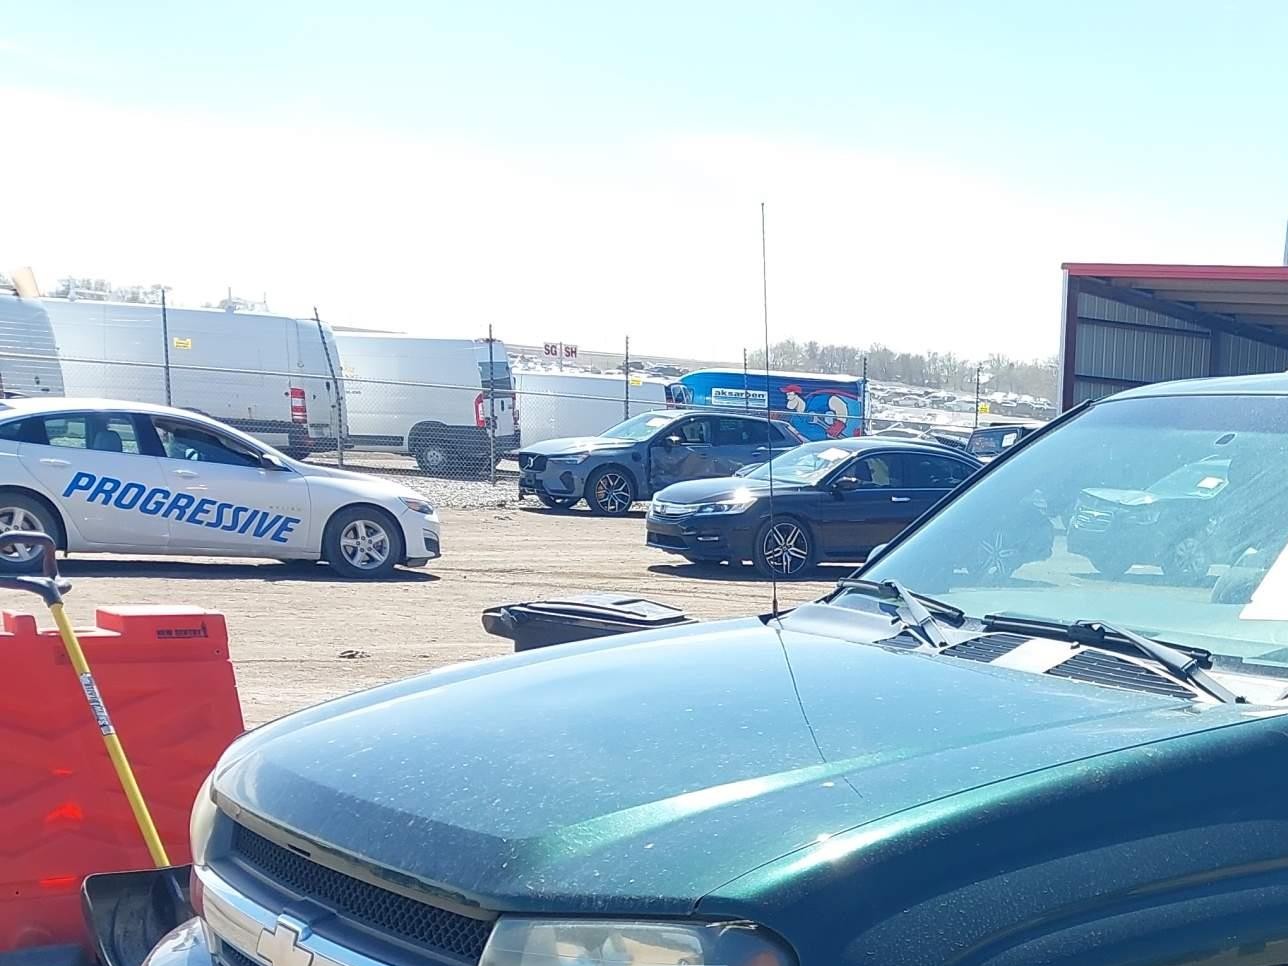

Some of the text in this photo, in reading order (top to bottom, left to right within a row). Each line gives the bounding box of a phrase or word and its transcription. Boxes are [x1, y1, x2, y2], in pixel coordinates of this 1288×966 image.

[544, 344, 557, 356] SG
[564, 346, 577, 358] SH
[714, 389, 765, 398] aksarben
[62, 471, 301, 543] PROGRESSIVE
